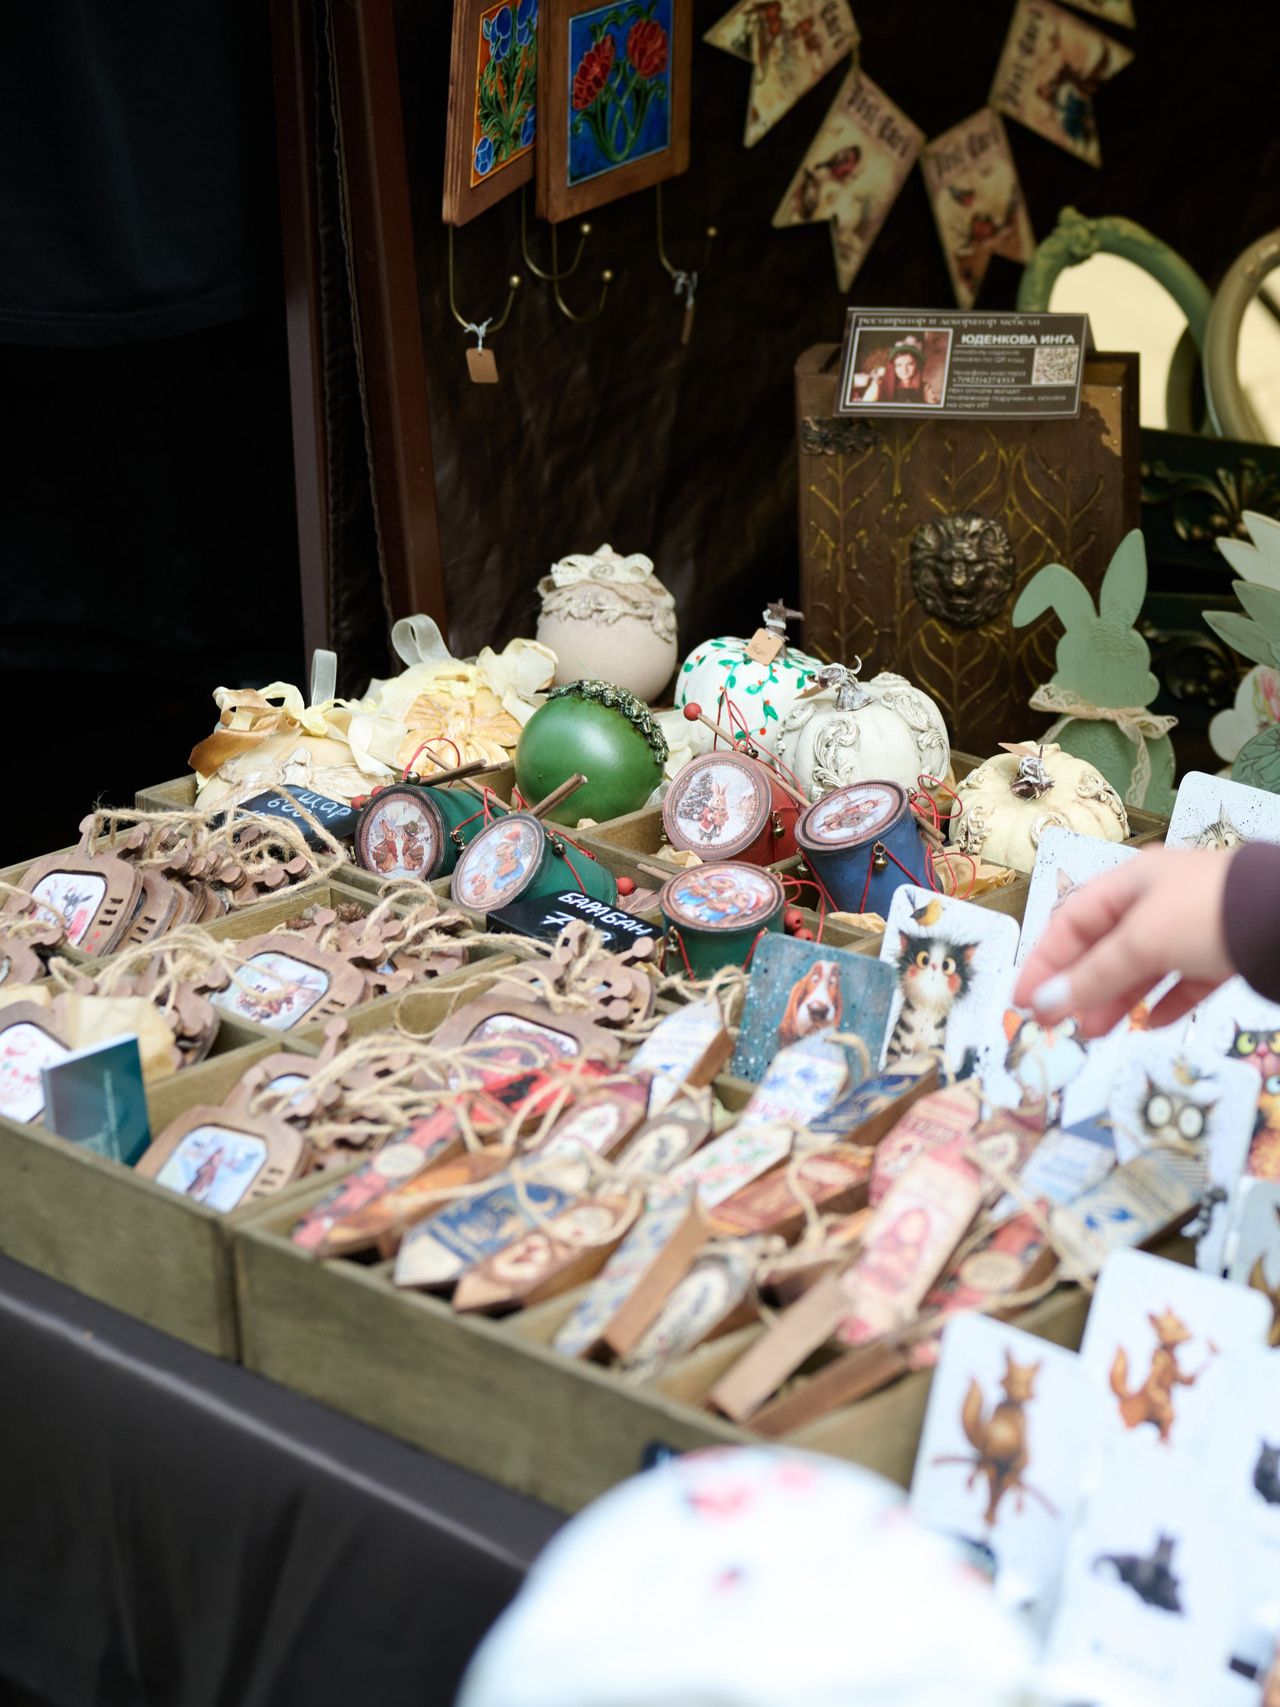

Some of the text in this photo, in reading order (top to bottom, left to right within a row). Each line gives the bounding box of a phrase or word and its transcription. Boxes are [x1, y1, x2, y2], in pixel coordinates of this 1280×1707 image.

[961, 333, 1075, 346] ЮДЕНКОВА ИНГА
[558, 892, 653, 936] БАРАБАН
